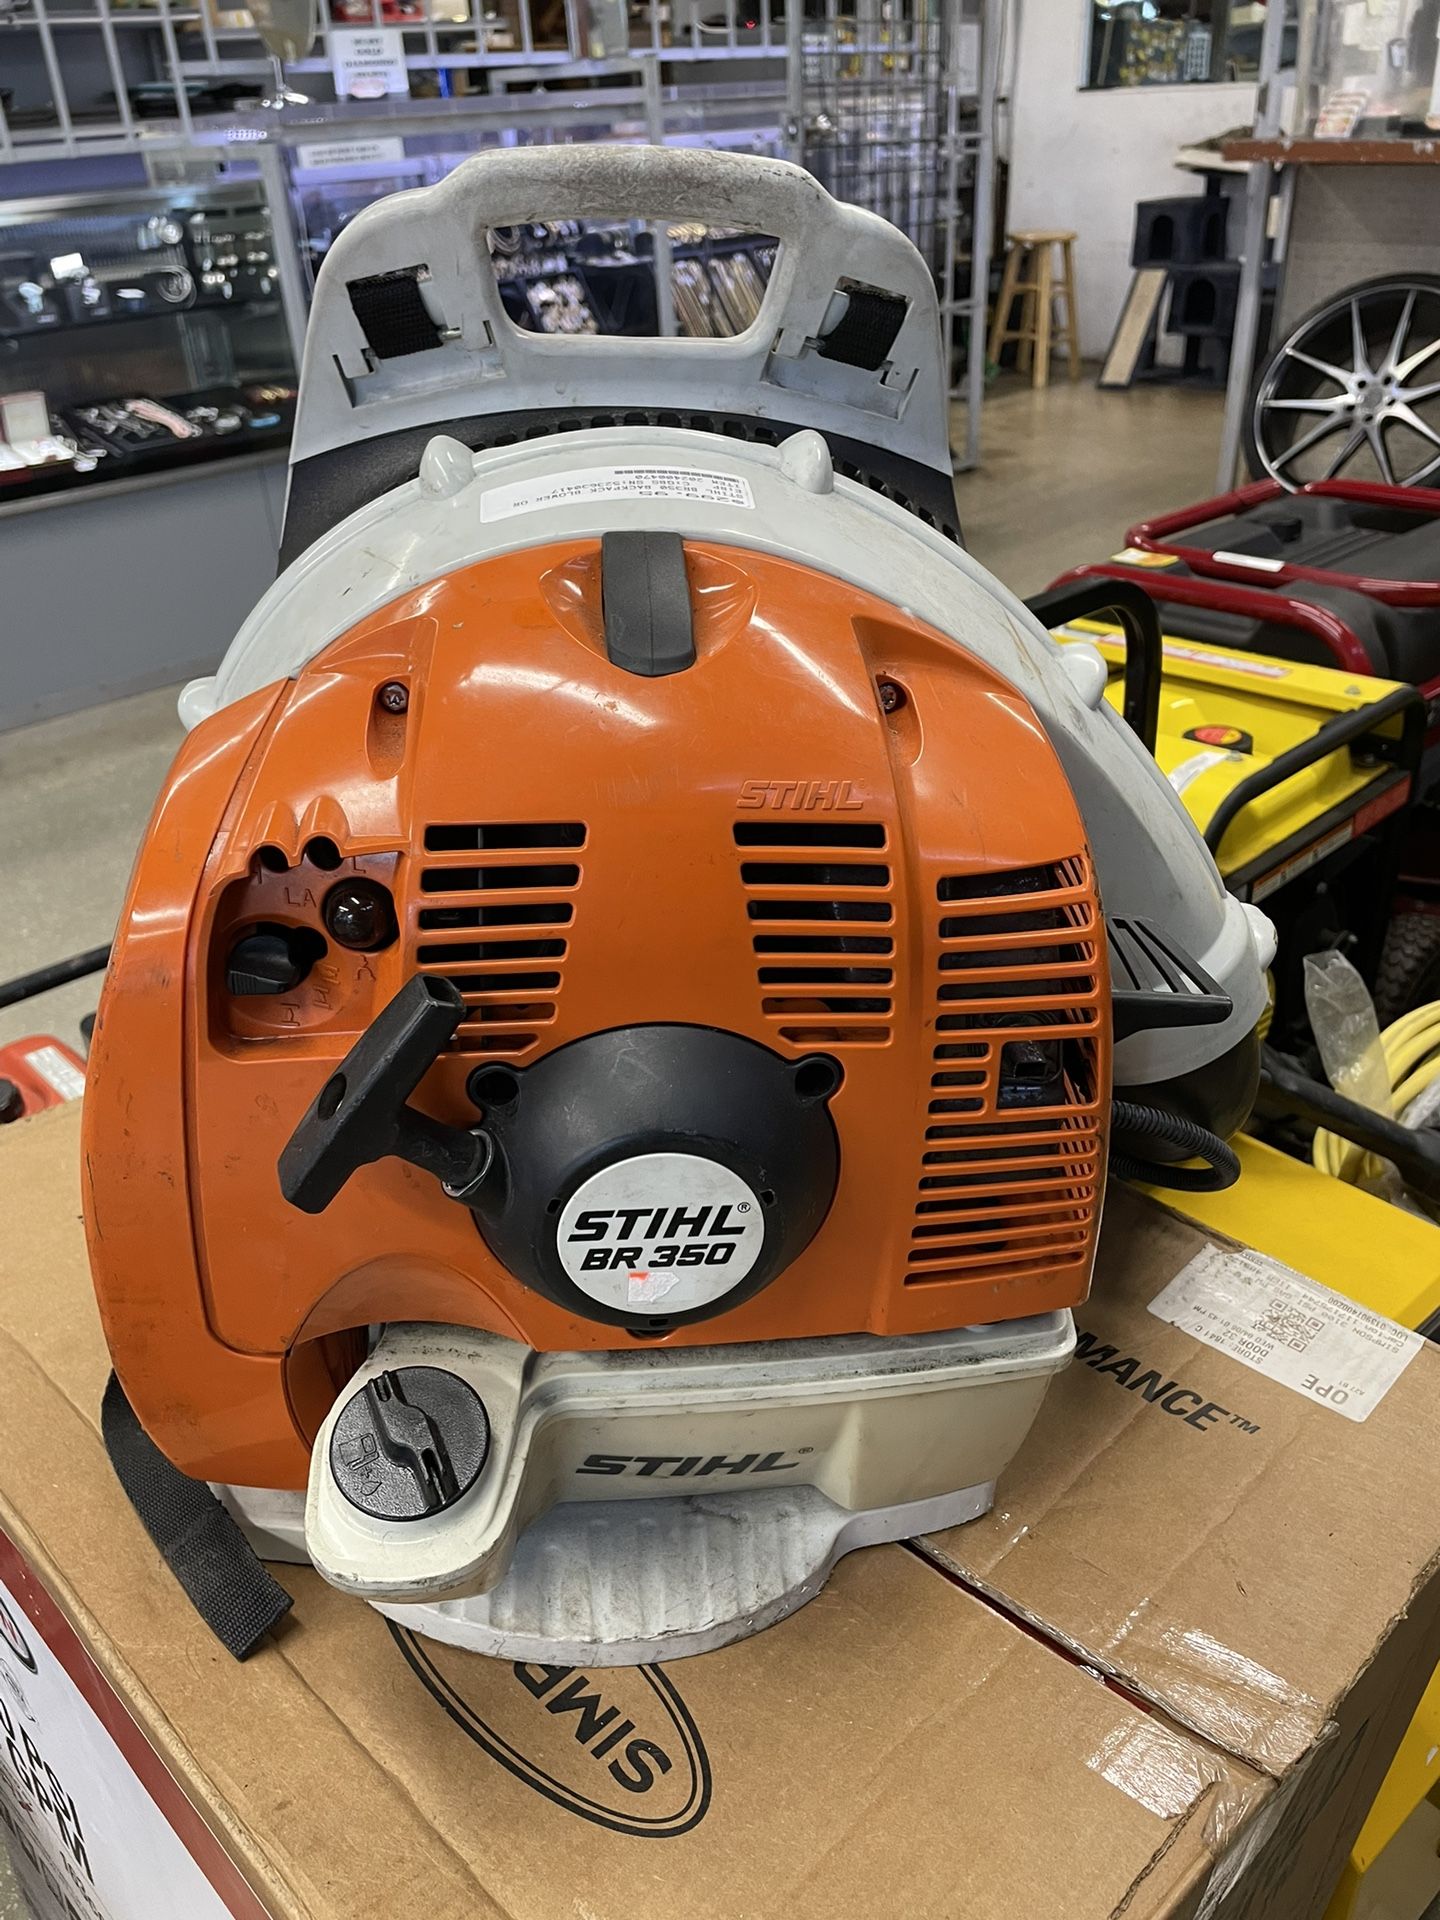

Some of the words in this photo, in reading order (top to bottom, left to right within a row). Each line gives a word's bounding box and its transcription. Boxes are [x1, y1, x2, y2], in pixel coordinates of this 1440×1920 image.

[535, 490, 581, 502] BLOWER
[590, 485, 652, 494] BACKPACK
[660, 484, 698, 493] BR350
[705, 488, 745, 500] STIHL
[736, 779, 864, 811] STIHL
[580, 1246, 644, 1271] BR
[648, 1242, 737, 1268] 350
[1222, 1329, 1237, 1341] 32
[1352, 1326, 1400, 1354] SIMPSON
[1237, 1337, 1270, 1358] DOOR
[1301, 1374, 1350, 1405] OPE
